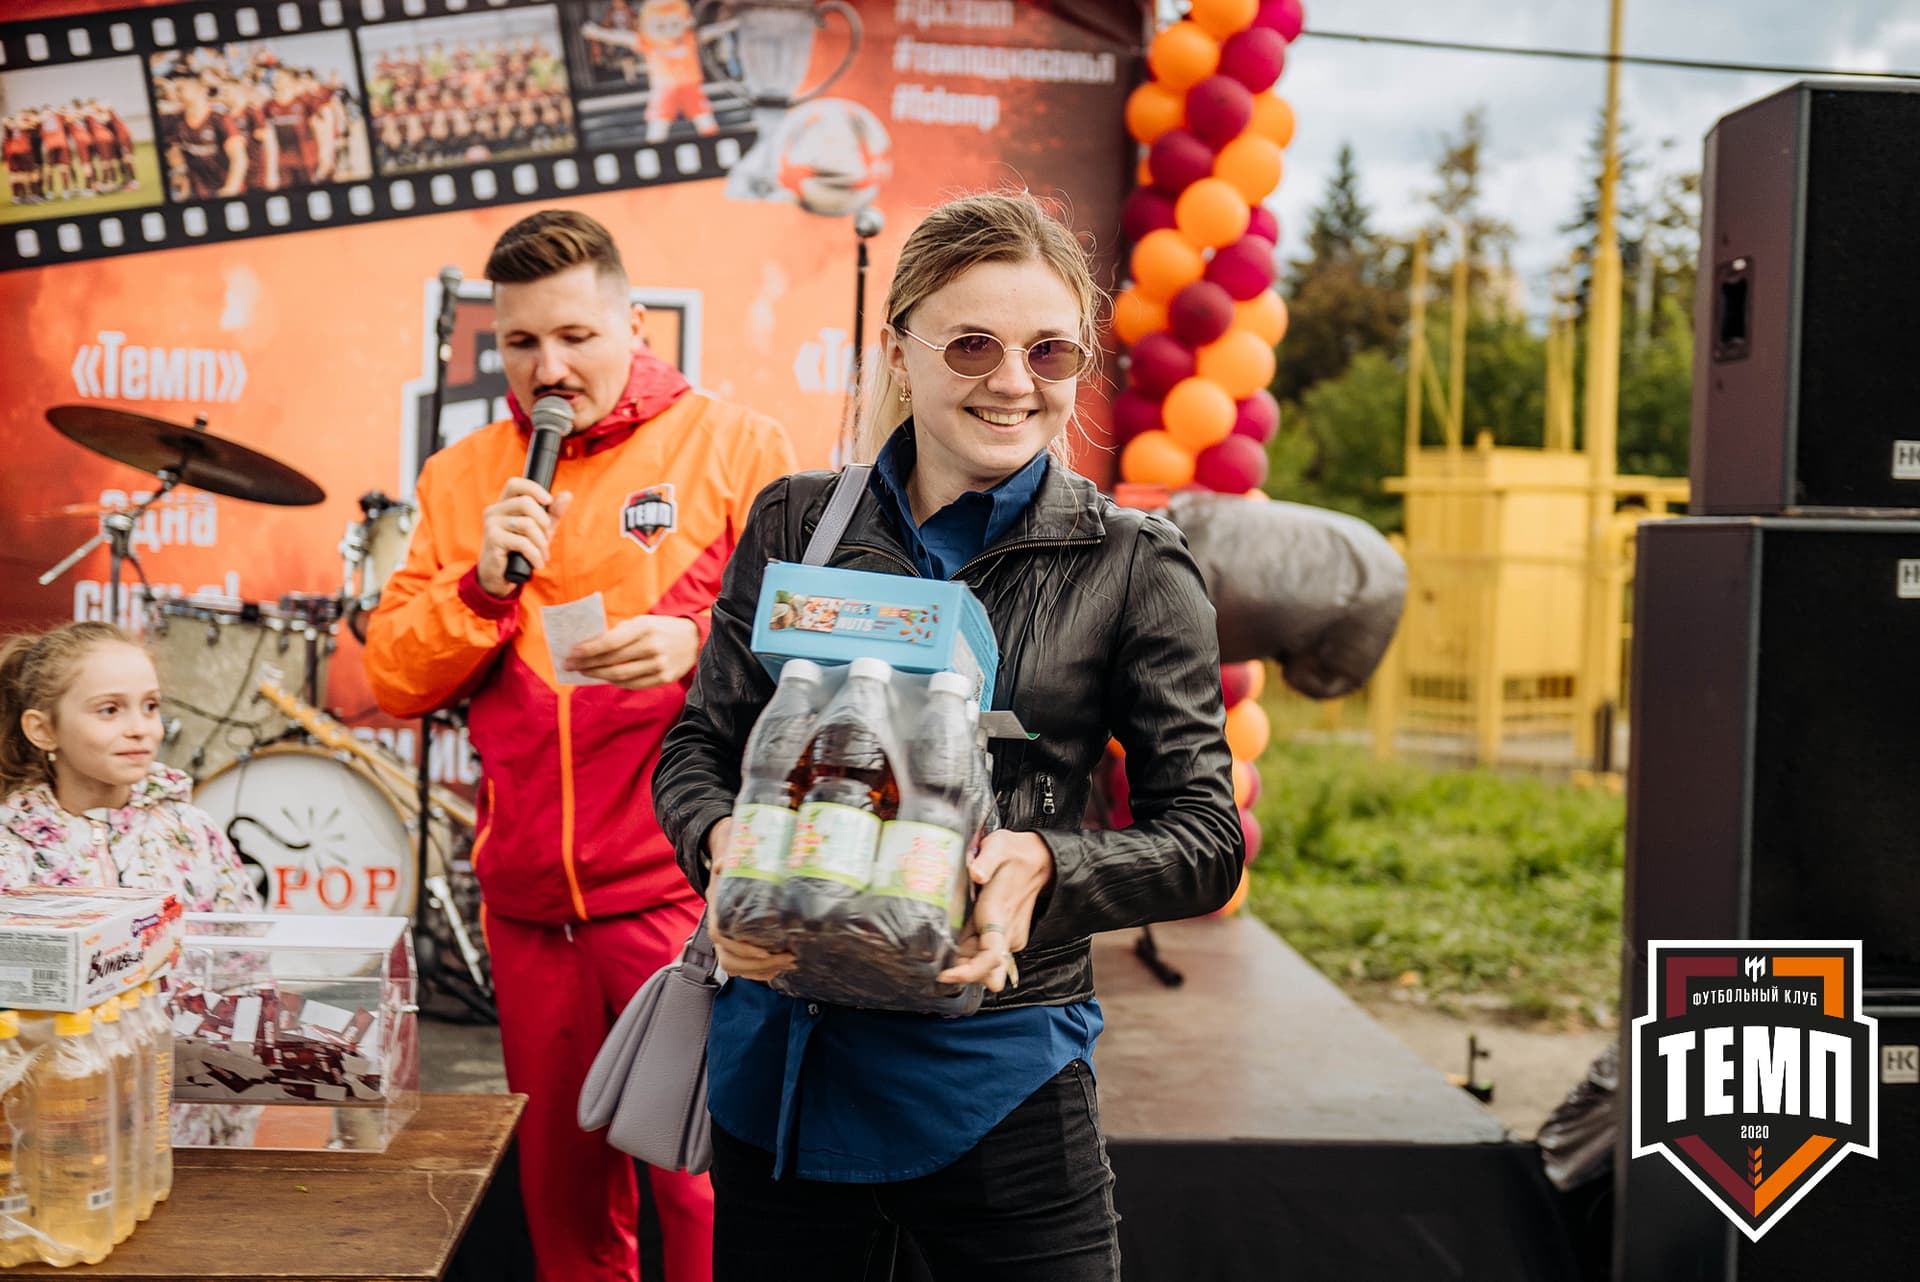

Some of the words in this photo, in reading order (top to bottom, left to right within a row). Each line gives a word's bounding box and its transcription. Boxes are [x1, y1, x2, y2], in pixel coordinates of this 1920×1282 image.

[72, 332, 247, 402] «Темп»
[626, 501, 672, 528] ТЕМП
[836, 617, 875, 632] NUTS
[273, 866, 397, 911] POP
[1887, 1051, 1916, 1070] HK
